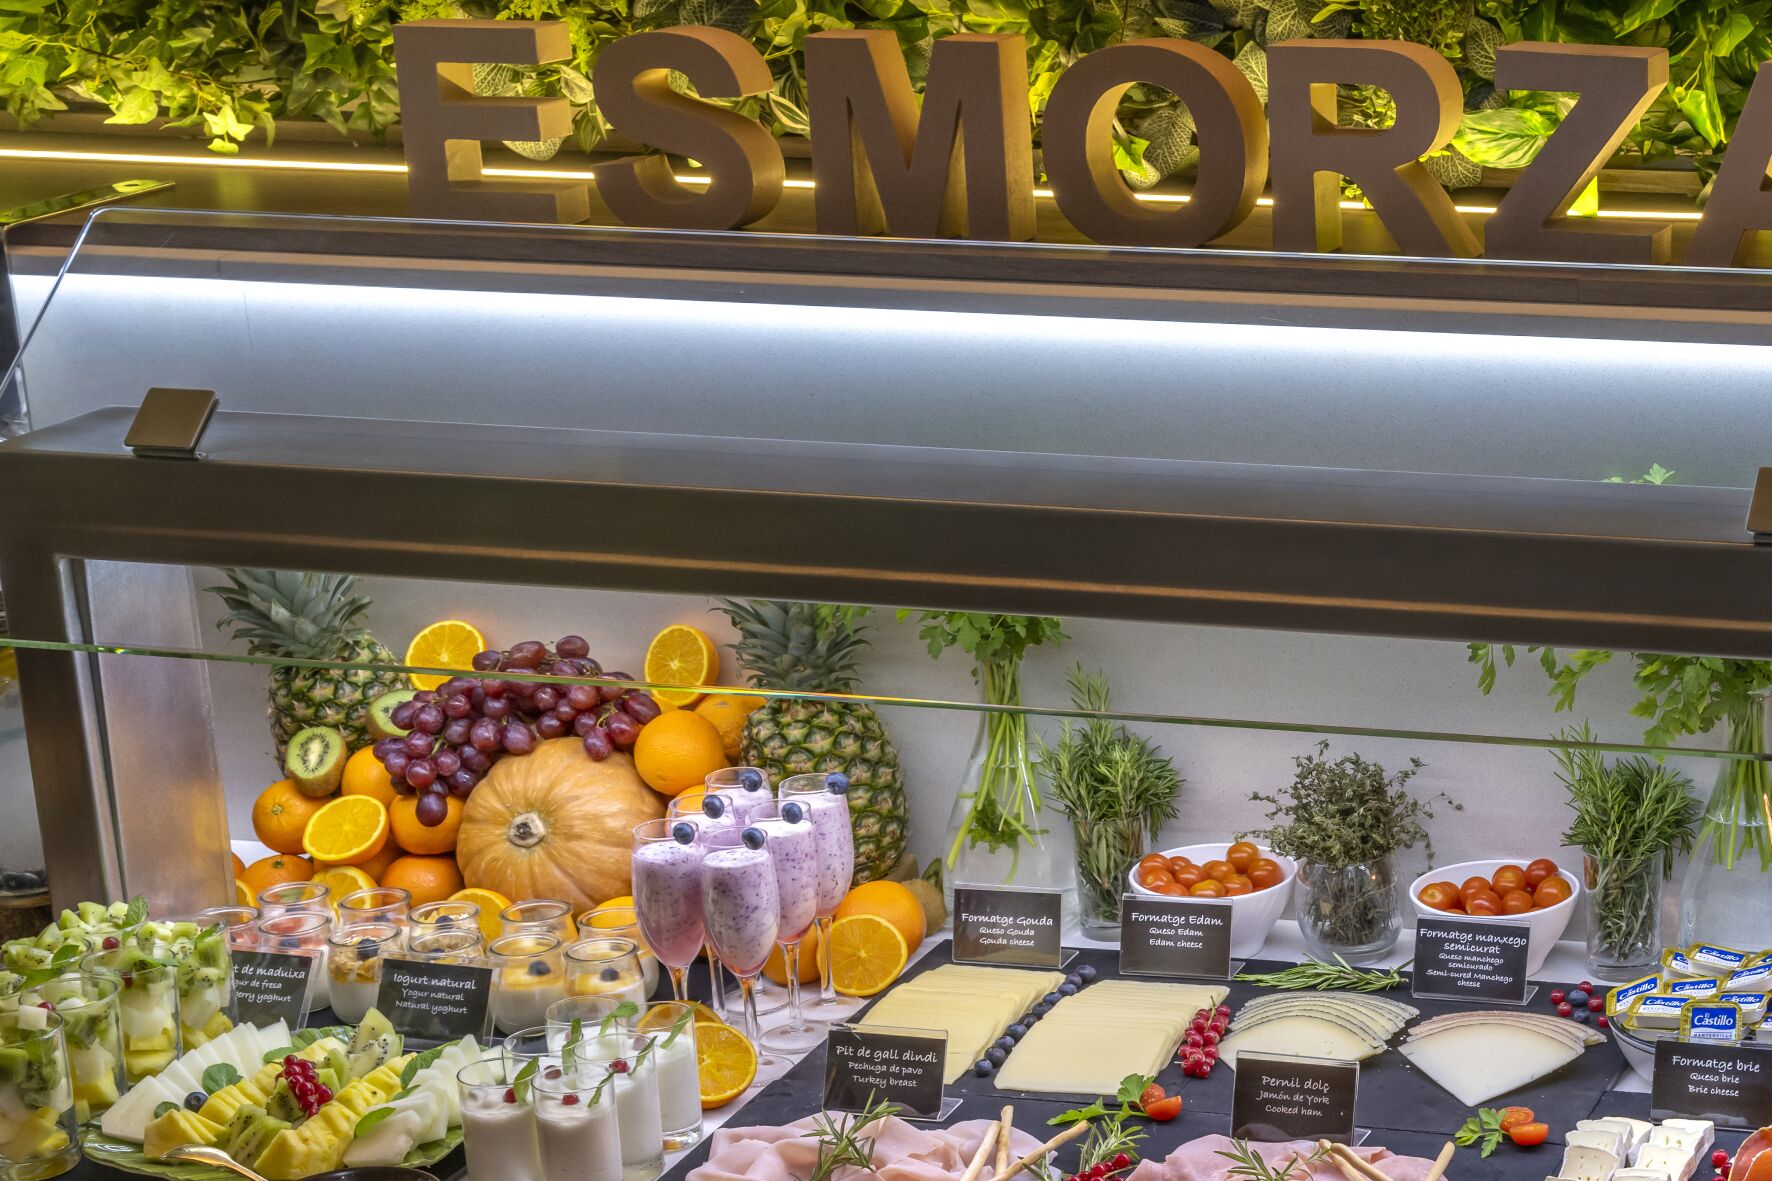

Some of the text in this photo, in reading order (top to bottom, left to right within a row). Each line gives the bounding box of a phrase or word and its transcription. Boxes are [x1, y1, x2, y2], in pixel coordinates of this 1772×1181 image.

[961, 913, 1053, 926] Formatge Gouda
[1131, 912, 1223, 926] Formatge Edam
[979, 926, 1035, 936] Queso Gouda
[1149, 927, 1204, 937] Queso Edam
[979, 937, 1035, 946] Gouda cheese
[1149, 938, 1203, 948] Edam cheese
[1420, 928, 1527, 947] Formatge manxego
[1443, 942, 1501, 954] semicurat
[1464, 955, 1504, 966] manchego
[1702, 949, 1739, 961] Castillo
[242, 964, 254, 974] de
[256, 967, 305, 979] maduixa
[1448, 961, 1493, 971] semicurado
[393, 973, 476, 989] Iogurt natural
[1426, 969, 1513, 984] Semi-cured Manchego
[261, 980, 282, 989] fresa
[1457, 979, 1481, 988] cheese
[402, 988, 464, 1000] Yogur natural
[1619, 983, 1654, 1000] Castillo
[257, 994, 292, 1003] yoghurt
[395, 1000, 468, 1014] Natural yoghurt
[1694, 1014, 1733, 1026] Castillo
[836, 1045, 938, 1063] Pit de gall dindi
[848, 1061, 923, 1076] Pechuga de pavo
[1672, 1055, 1760, 1072] Formatge brie
[852, 1075, 917, 1088] Turkey breast
[1689, 1072, 1740, 1084] Queso brie
[1262, 1075, 1330, 1094] Pernil dolç
[1687, 1084, 1739, 1097] Brie cheese
[1255, 1090, 1330, 1106] Jamón de York
[1265, 1104, 1323, 1116] Cooked ham
